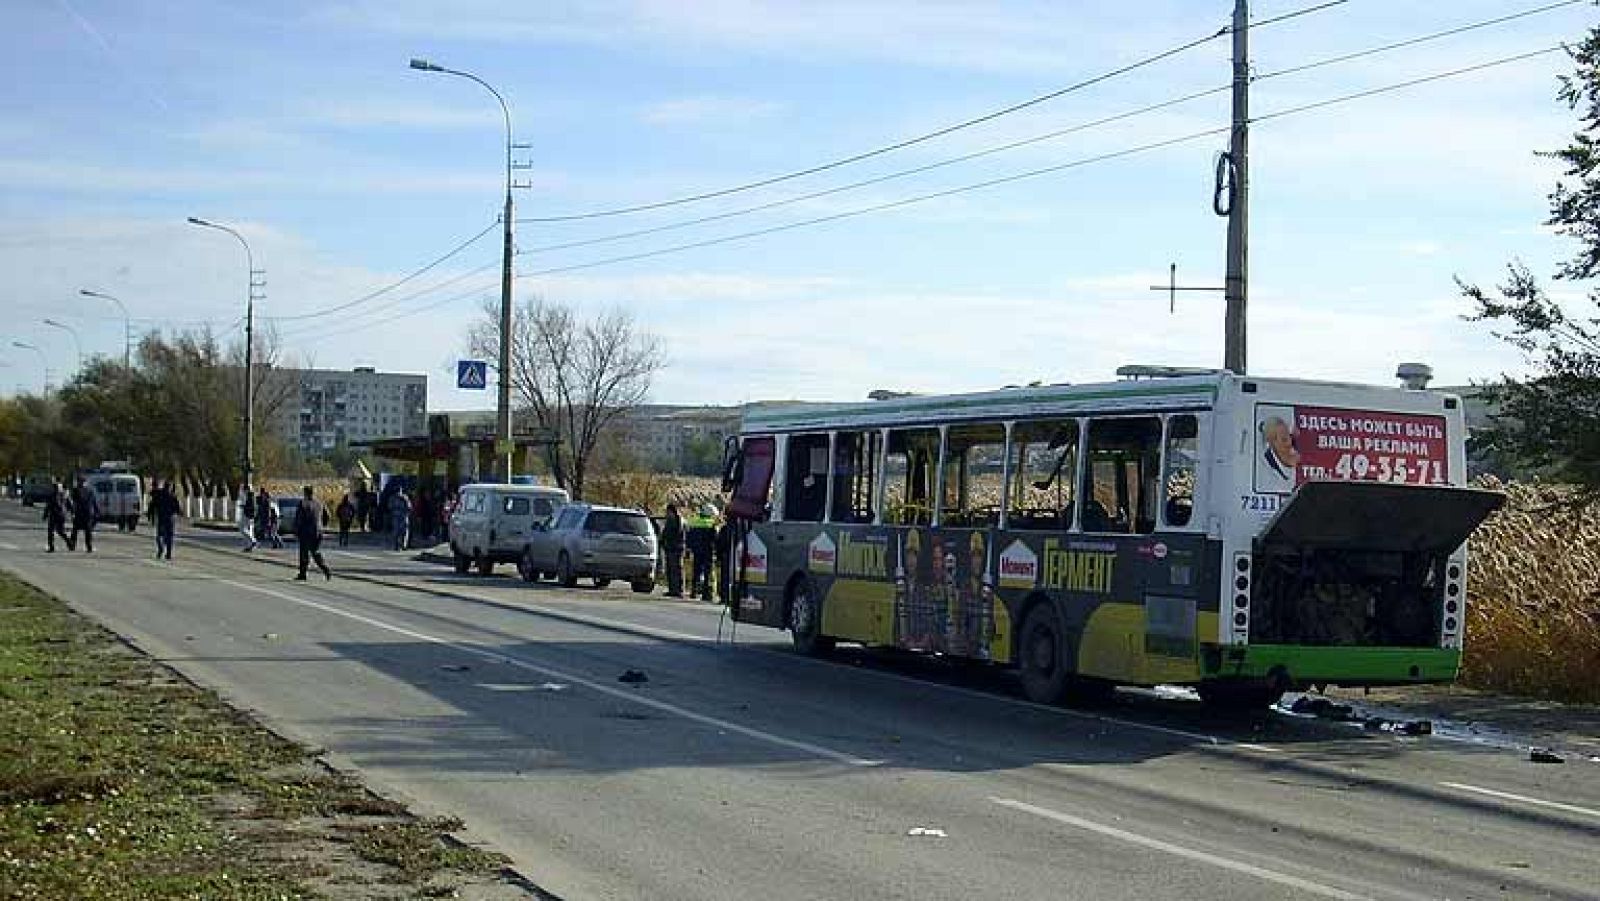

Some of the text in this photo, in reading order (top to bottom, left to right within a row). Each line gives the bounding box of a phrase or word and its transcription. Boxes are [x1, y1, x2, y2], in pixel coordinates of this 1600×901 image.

[1299, 414, 1443, 439] ЗДЕСЬ МОЖЕТ БЫТЬ
[1318, 435, 1428, 456] ВАША РЕКЛАМА
[1334, 454, 1445, 486] 49-35-71
